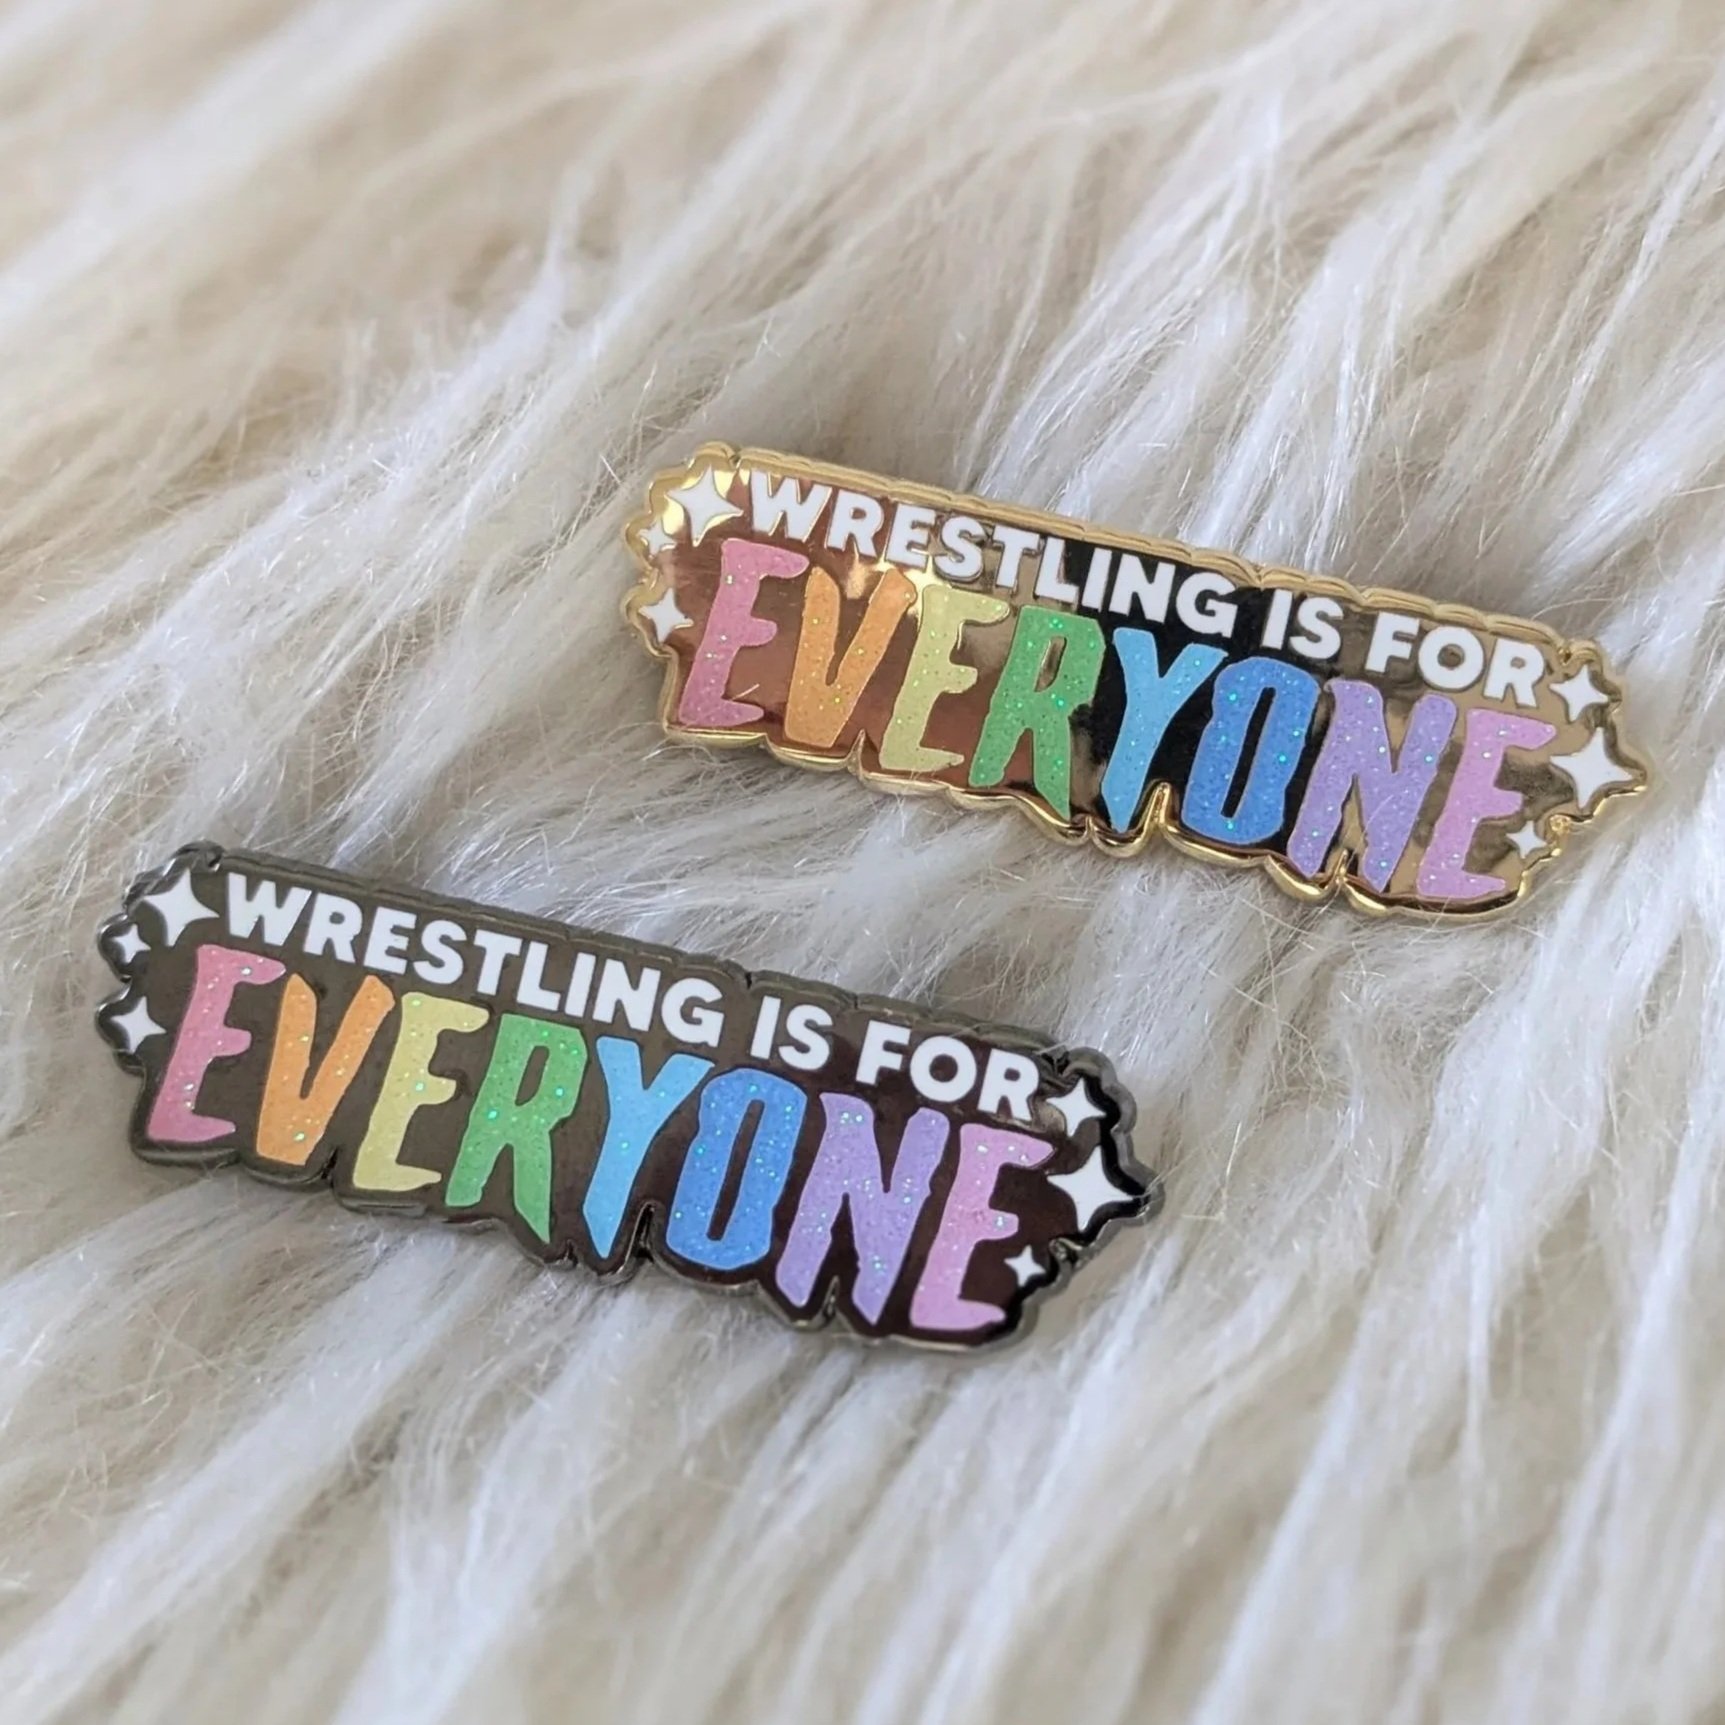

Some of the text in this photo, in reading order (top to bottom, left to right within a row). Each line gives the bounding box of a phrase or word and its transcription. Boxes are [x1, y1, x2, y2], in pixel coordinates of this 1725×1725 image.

[679, 538, 1556, 899] EVERYONE
[749, 470, 1544, 707] WRESTLING IS FOR
[147, 944, 1055, 1330] EVERYONE
[227, 872, 1039, 1123] WRESTLING IS FOR
